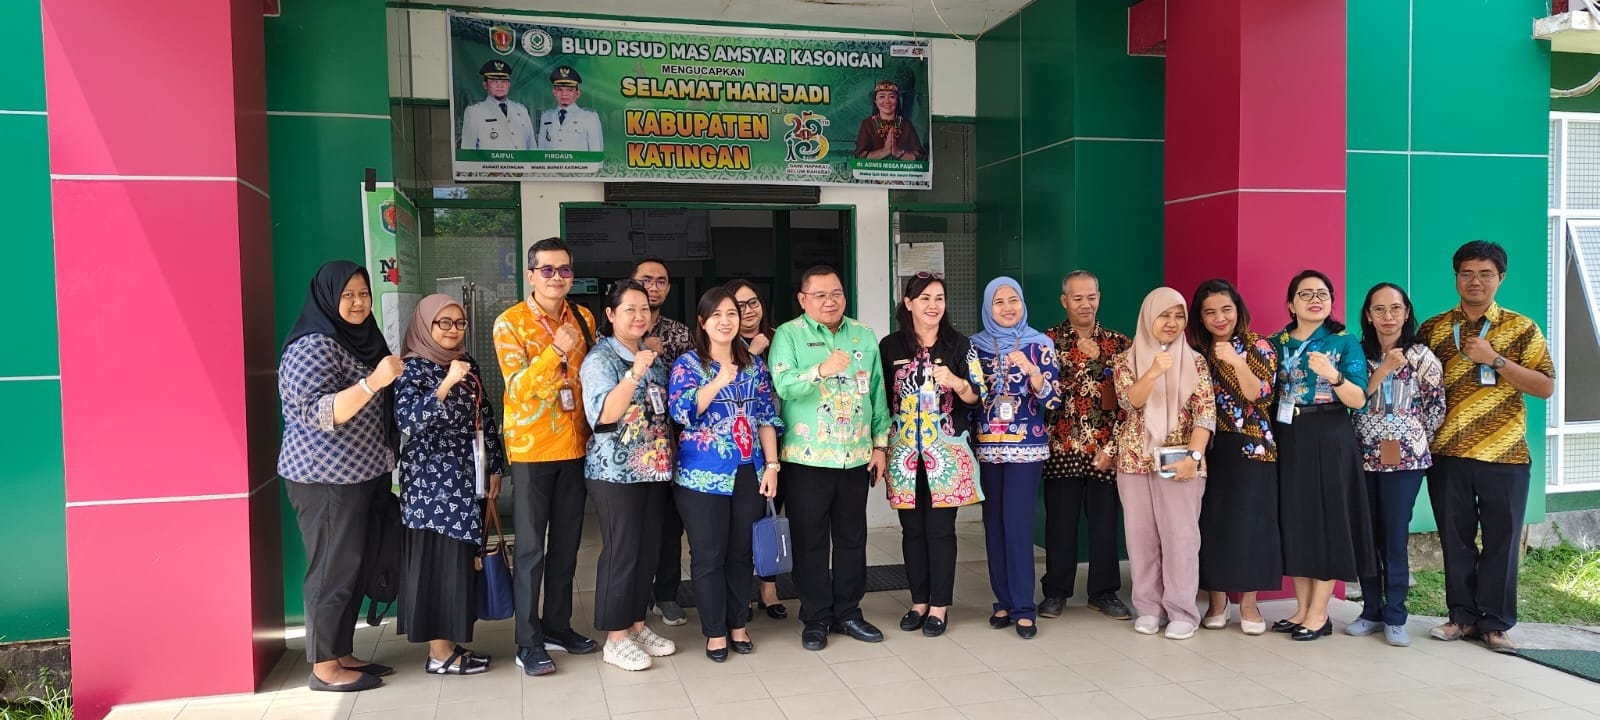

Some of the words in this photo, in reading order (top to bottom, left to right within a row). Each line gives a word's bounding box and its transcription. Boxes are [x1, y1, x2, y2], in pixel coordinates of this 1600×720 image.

[561, 37, 612, 56] BLUD
[617, 40, 666, 58] RSUD
[671, 43, 710, 61] MAS
[713, 46, 786, 64] AMSYAR
[790, 50, 883, 68] KASONGAN
[661, 65, 745, 77] MENGUCAPKAN
[622, 78, 723, 100] SELAMAT
[726, 82, 778, 102] HARI
[781, 84, 830, 103] JADI
[625, 110, 769, 140] KABUPATEN
[627, 143, 751, 169] KATINGAN
